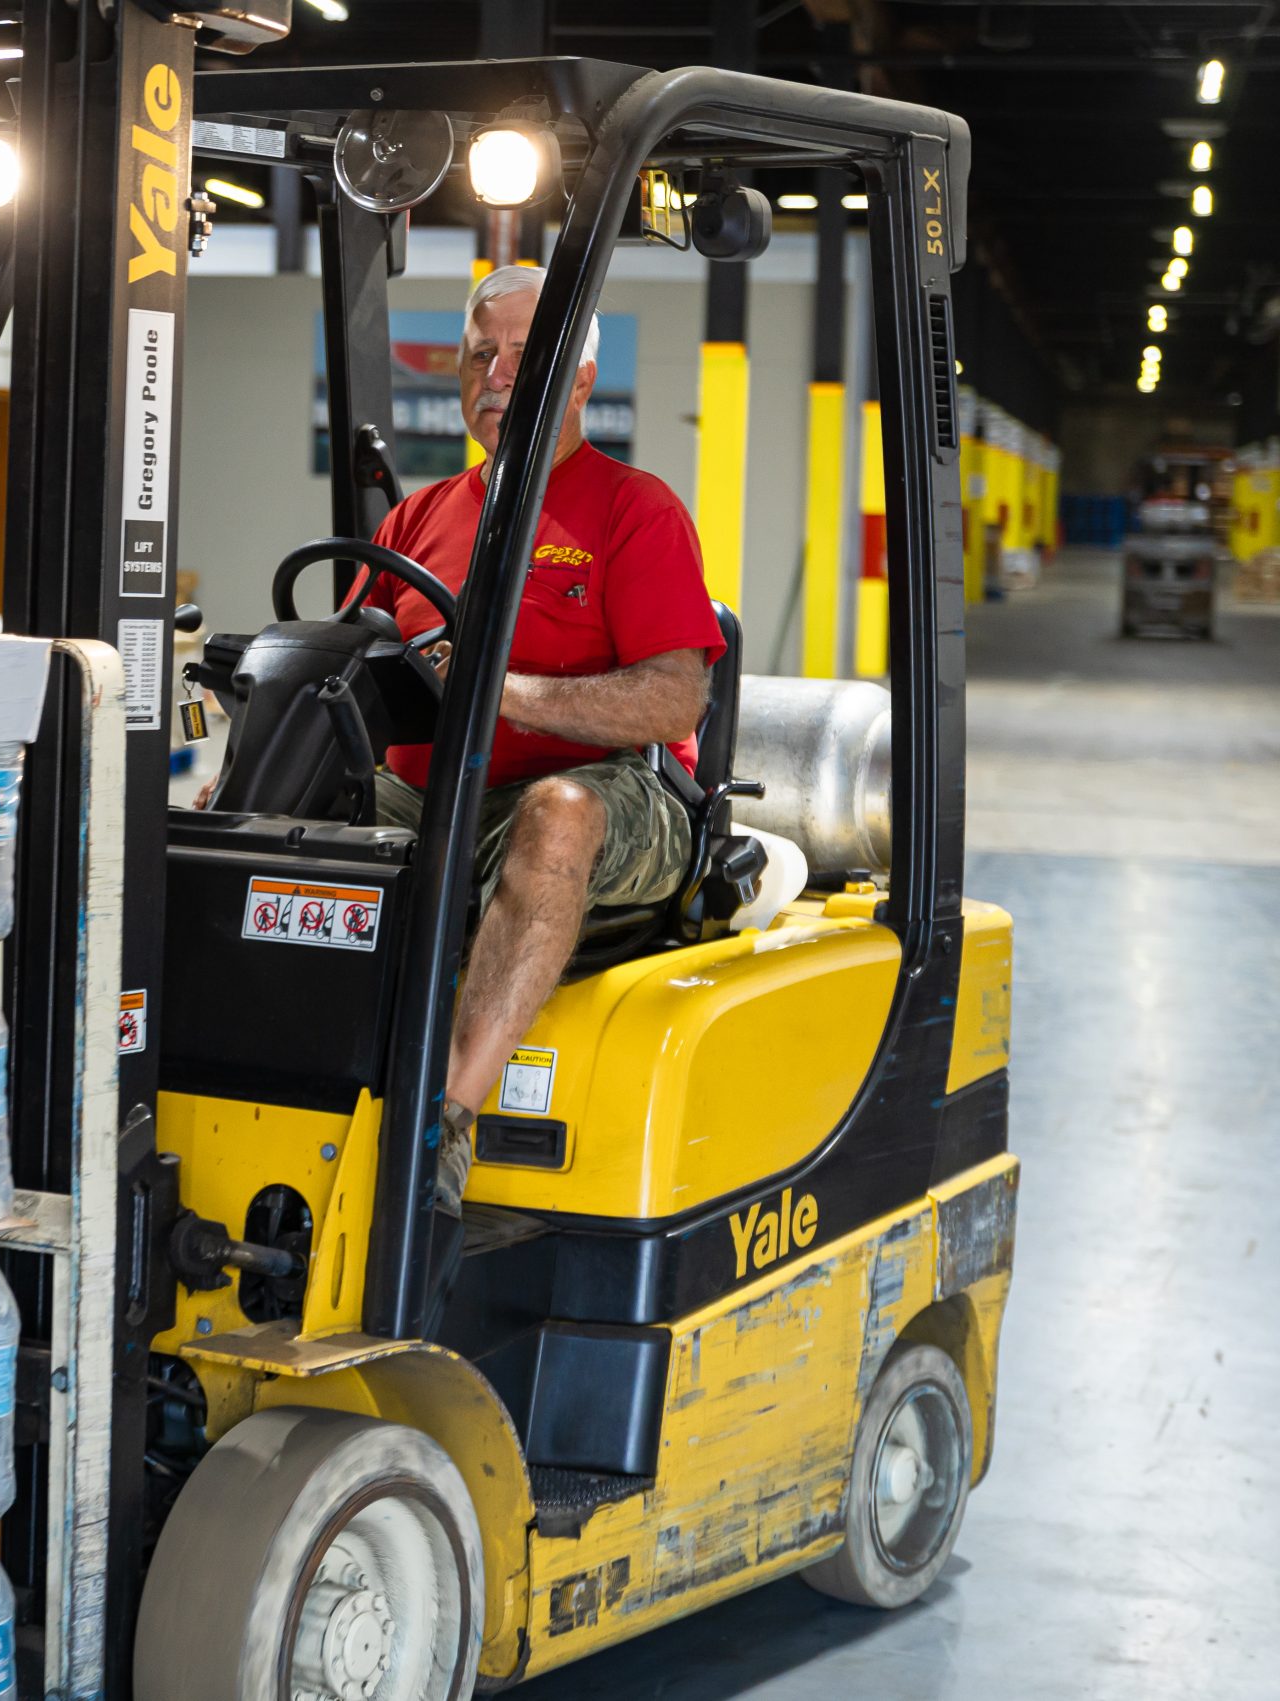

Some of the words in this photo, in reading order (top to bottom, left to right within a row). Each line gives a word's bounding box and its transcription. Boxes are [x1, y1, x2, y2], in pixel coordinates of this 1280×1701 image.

[128, 63, 182, 284] Yale
[142, 329, 159, 401] Poole
[138, 411, 159, 511] Gregory
[123, 560, 162, 573] SYSTEMS
[134, 541, 154, 553] LIFT
[304, 887, 337, 897] WARNING
[520, 1055, 552, 1064] CAUTION
[729, 1186, 819, 1280] Yale
